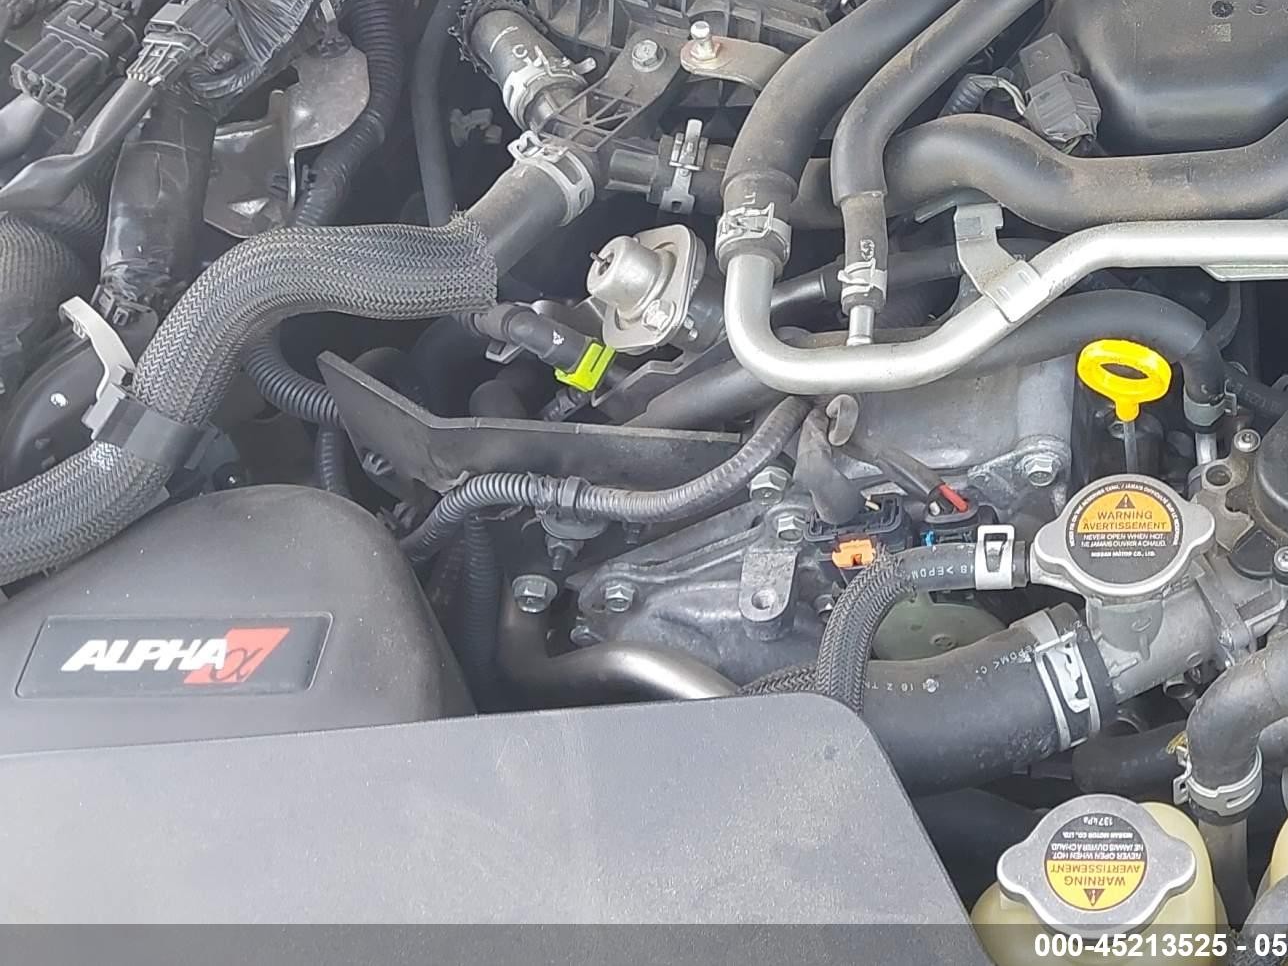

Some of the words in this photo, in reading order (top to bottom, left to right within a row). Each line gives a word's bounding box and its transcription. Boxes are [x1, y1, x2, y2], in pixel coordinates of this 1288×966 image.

[1097, 511, 1153, 520] WARNING
[1083, 521, 1168, 530] AVERTISSEMENT
[60, 638, 228, 671] ALPHA
[1098, 816, 1113, 826] 137
[1109, 843, 1133, 851] JAMAIS
[1069, 852, 1094, 860] WHEN
[1095, 852, 1115, 860] OPEN
[1116, 852, 1142, 860] NEVER
[1051, 864, 1141, 873] AVERTISSEMENT
[1064, 876, 1126, 886] WARNING
